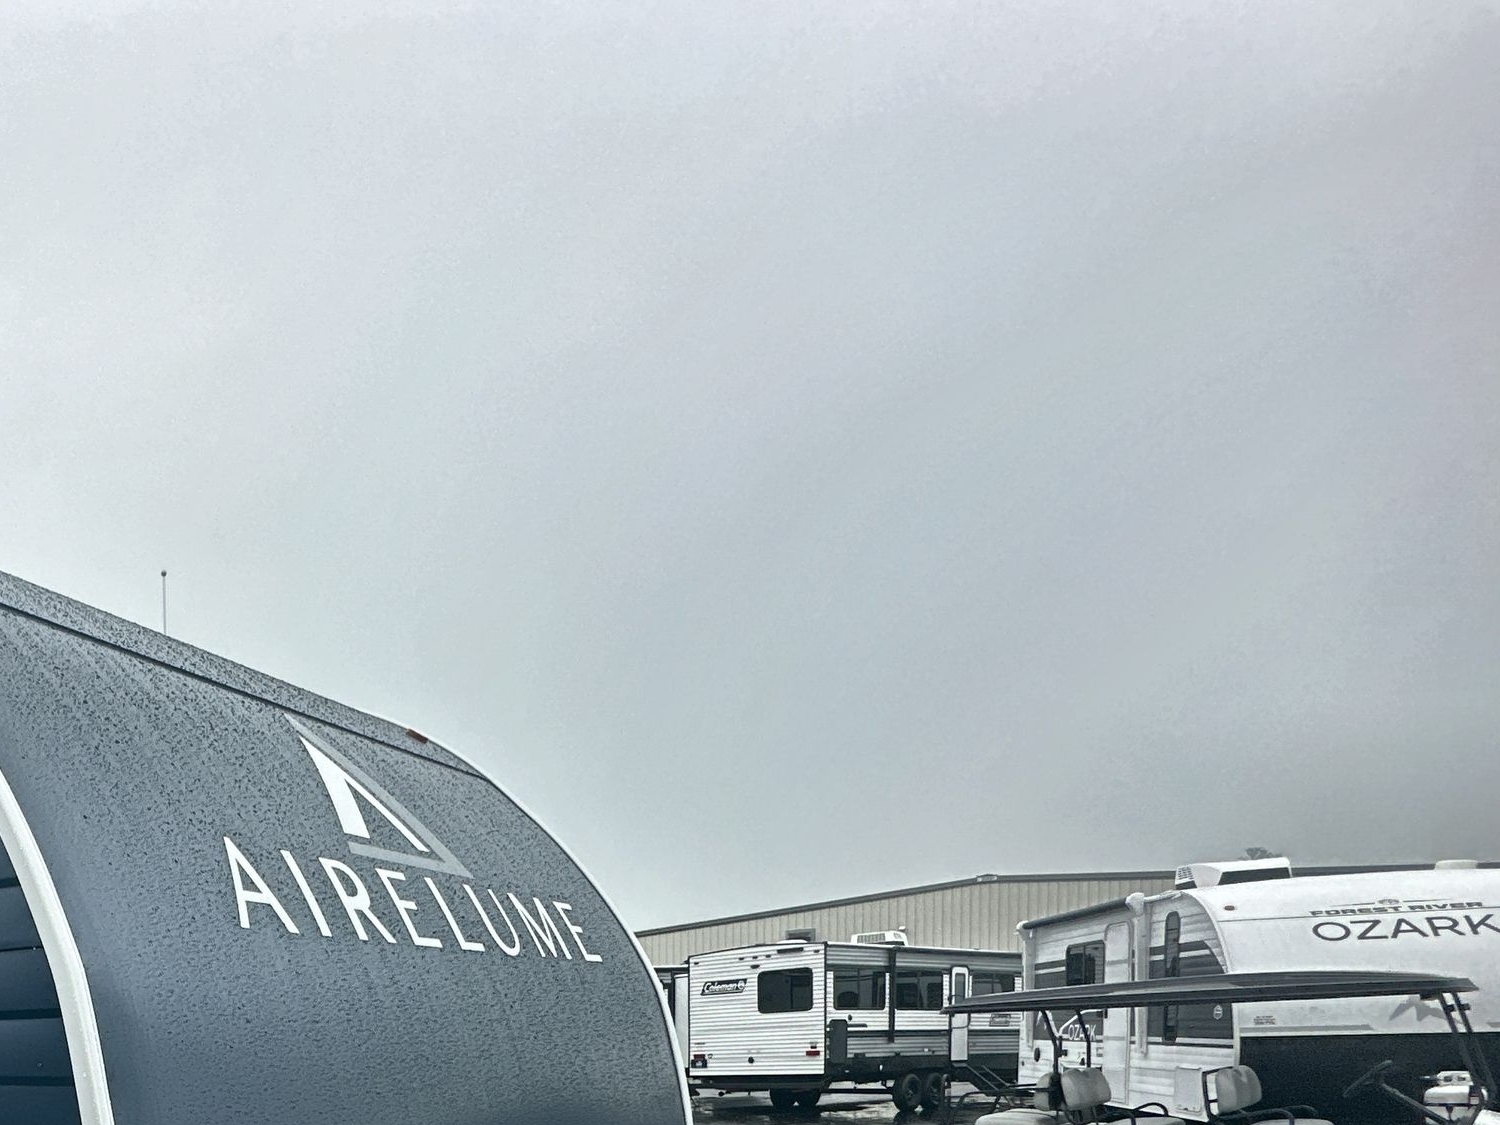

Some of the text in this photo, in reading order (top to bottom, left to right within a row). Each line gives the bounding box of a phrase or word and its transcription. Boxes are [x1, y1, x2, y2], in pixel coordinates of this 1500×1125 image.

[223, 836, 603, 962] AIRELUME
[1309, 902, 1483, 916] FOREST RIVER
[1311, 913, 1500, 942] OZARK
[704, 981, 737, 993] Coleman
